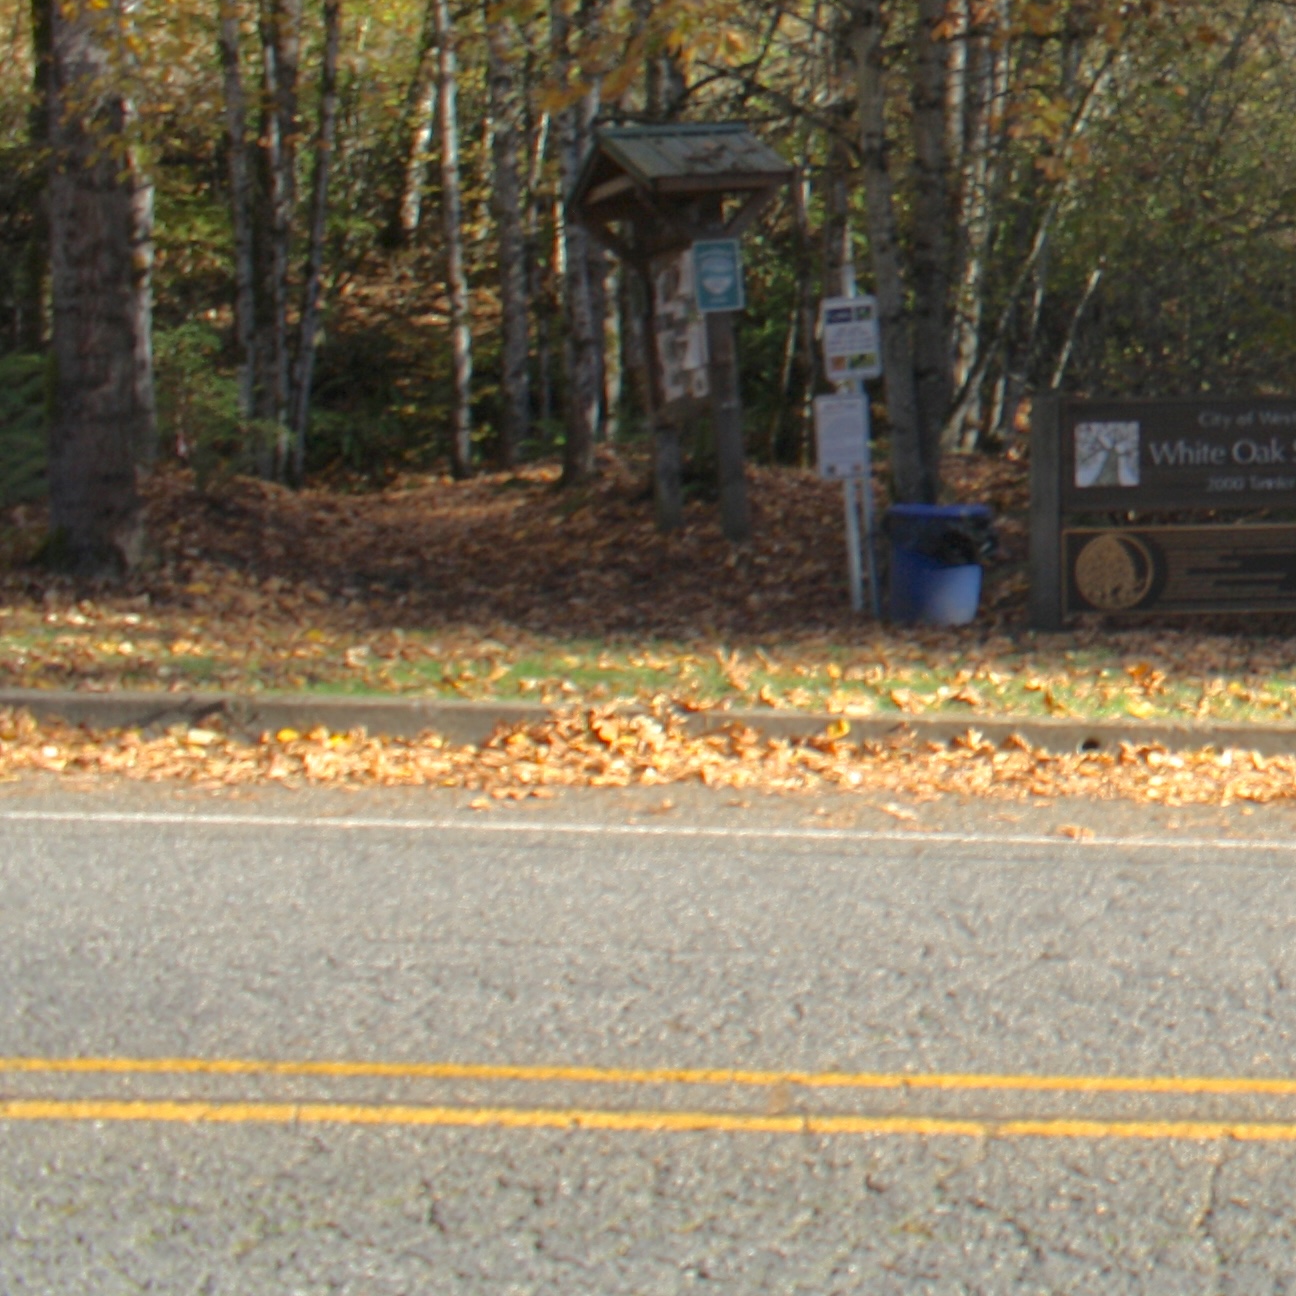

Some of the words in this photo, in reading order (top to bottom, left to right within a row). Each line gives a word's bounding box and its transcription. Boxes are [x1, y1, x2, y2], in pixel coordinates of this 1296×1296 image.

[1198, 410, 1231, 429] City
[1236, 408, 1254, 425] of
[1149, 439, 1226, 465] White
[1231, 438, 1285, 464] Oak
